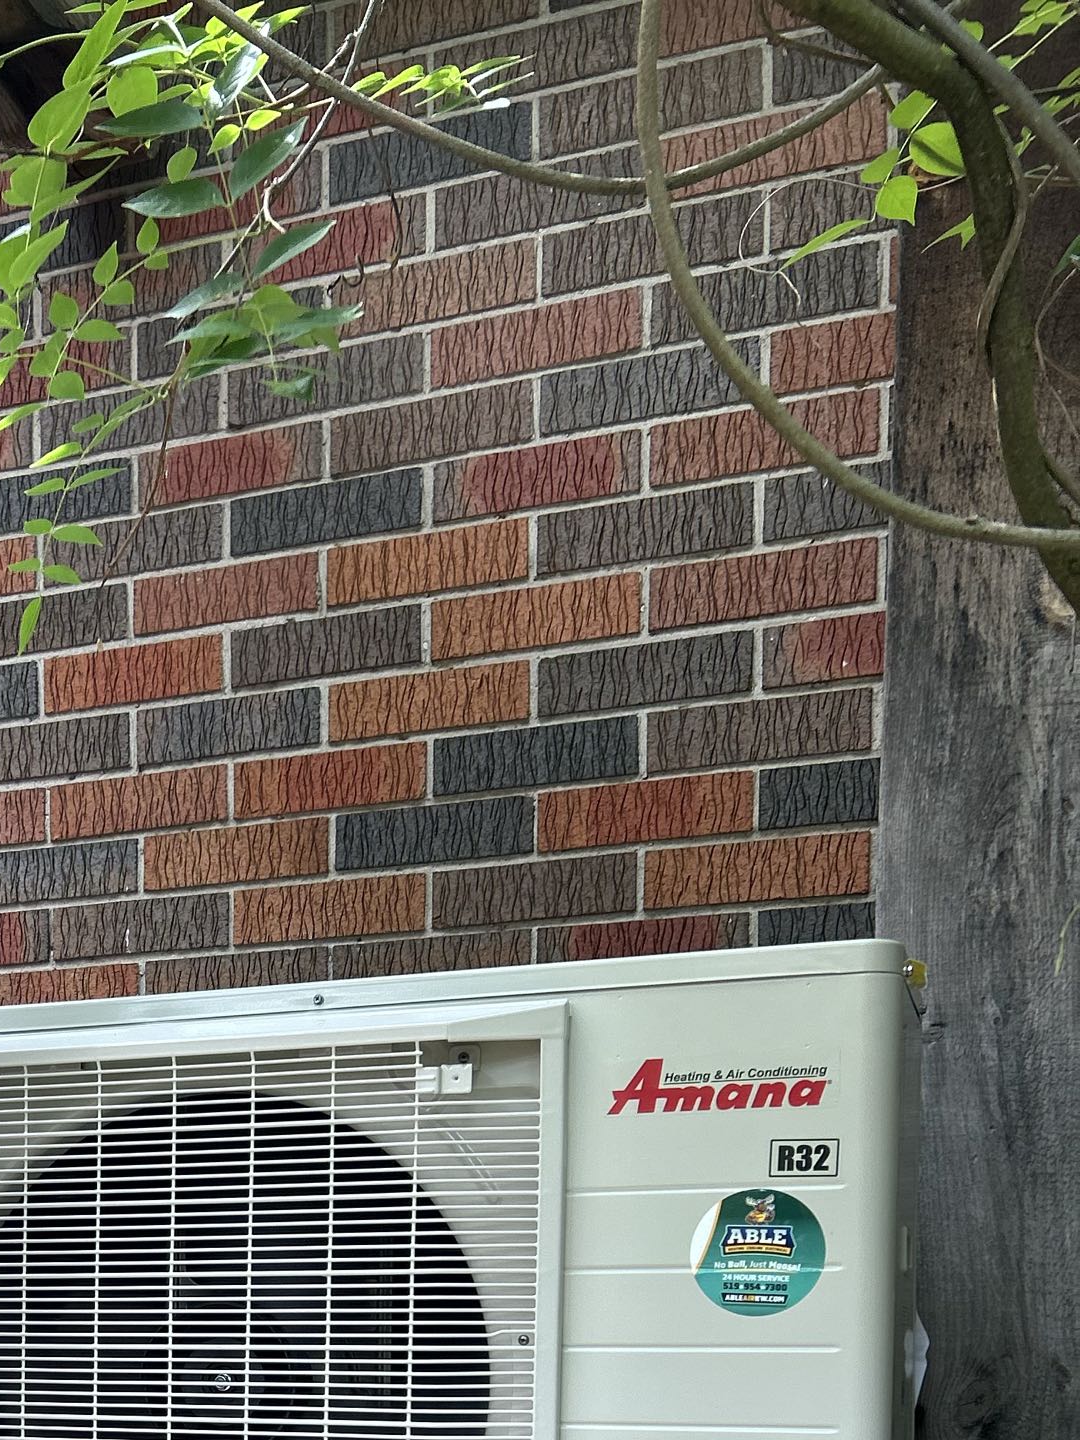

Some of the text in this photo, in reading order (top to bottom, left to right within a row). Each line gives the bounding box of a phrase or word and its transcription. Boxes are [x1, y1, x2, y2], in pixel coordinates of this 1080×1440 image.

[664, 1065, 828, 1084] Heating & Air Conditioning
[607, 1058, 827, 1115] Amana
[777, 1144, 831, 1172] R32
[727, 1228, 787, 1245] ABLE
[714, 1261, 726, 1269] No
[750, 1261, 767, 1269] Just
